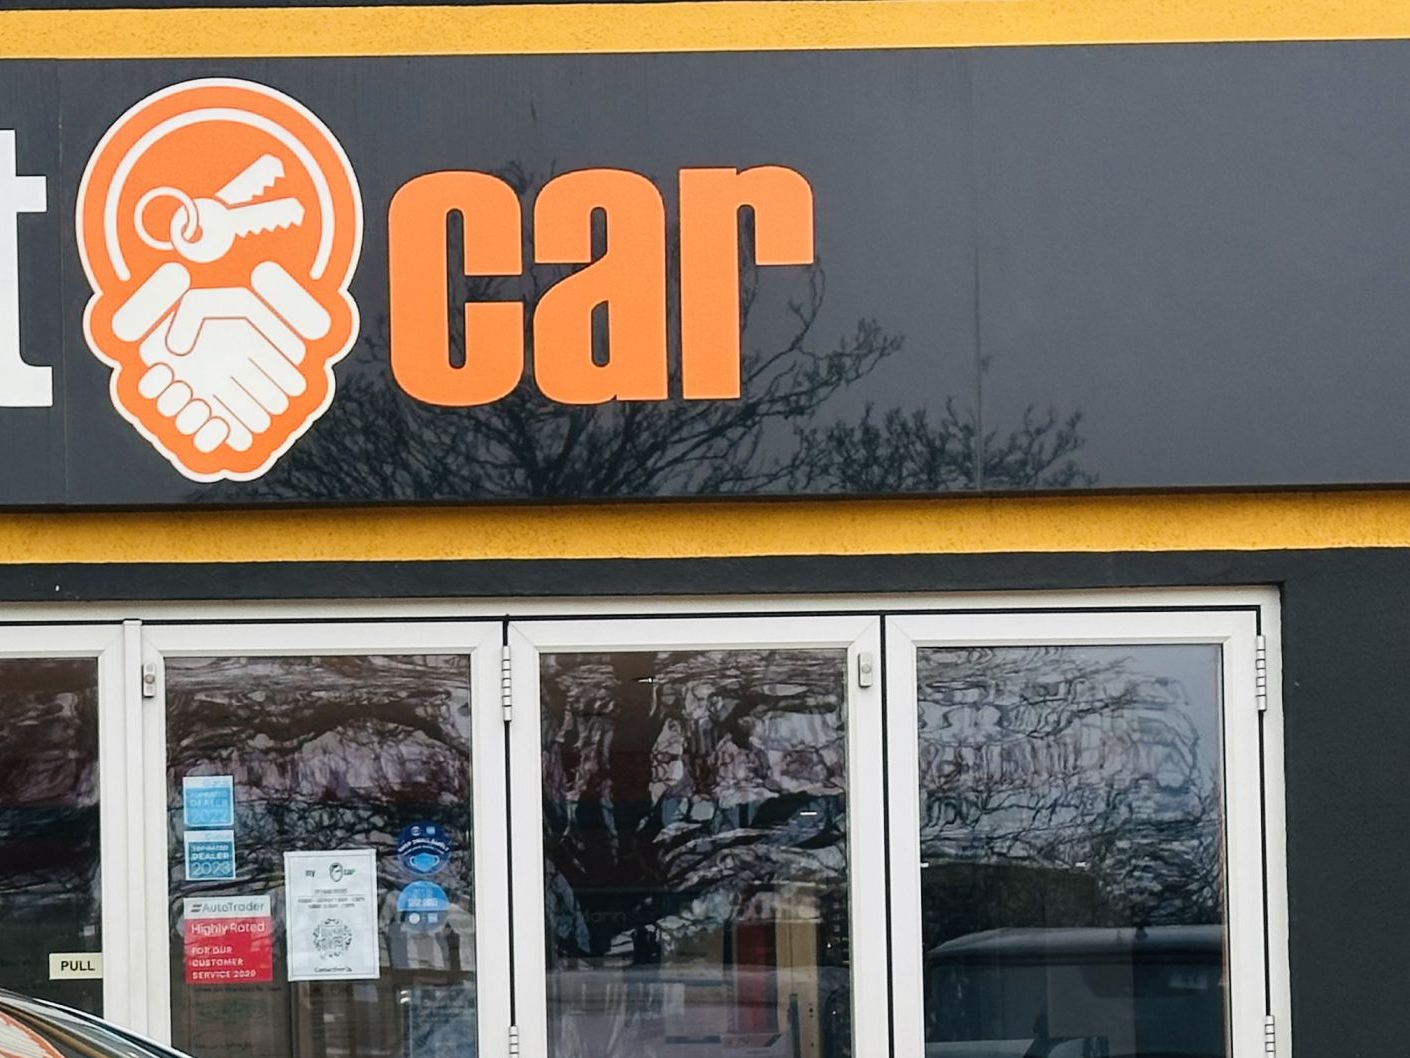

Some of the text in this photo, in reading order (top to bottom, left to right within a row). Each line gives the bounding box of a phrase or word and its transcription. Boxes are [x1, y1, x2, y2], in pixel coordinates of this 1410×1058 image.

[387, 165, 815, 406] car
[191, 852, 229, 861] DEALER
[191, 861, 231, 876] 2023
[201, 902, 265, 913] AutoTrader
[191, 921, 265, 937] Highly Rated
[191, 946, 233, 955] FOR OUR
[60, 960, 95, 972] PULL
[191, 957, 244, 967] CUSTOMER
[192, 970, 231, 980] SERVICE
